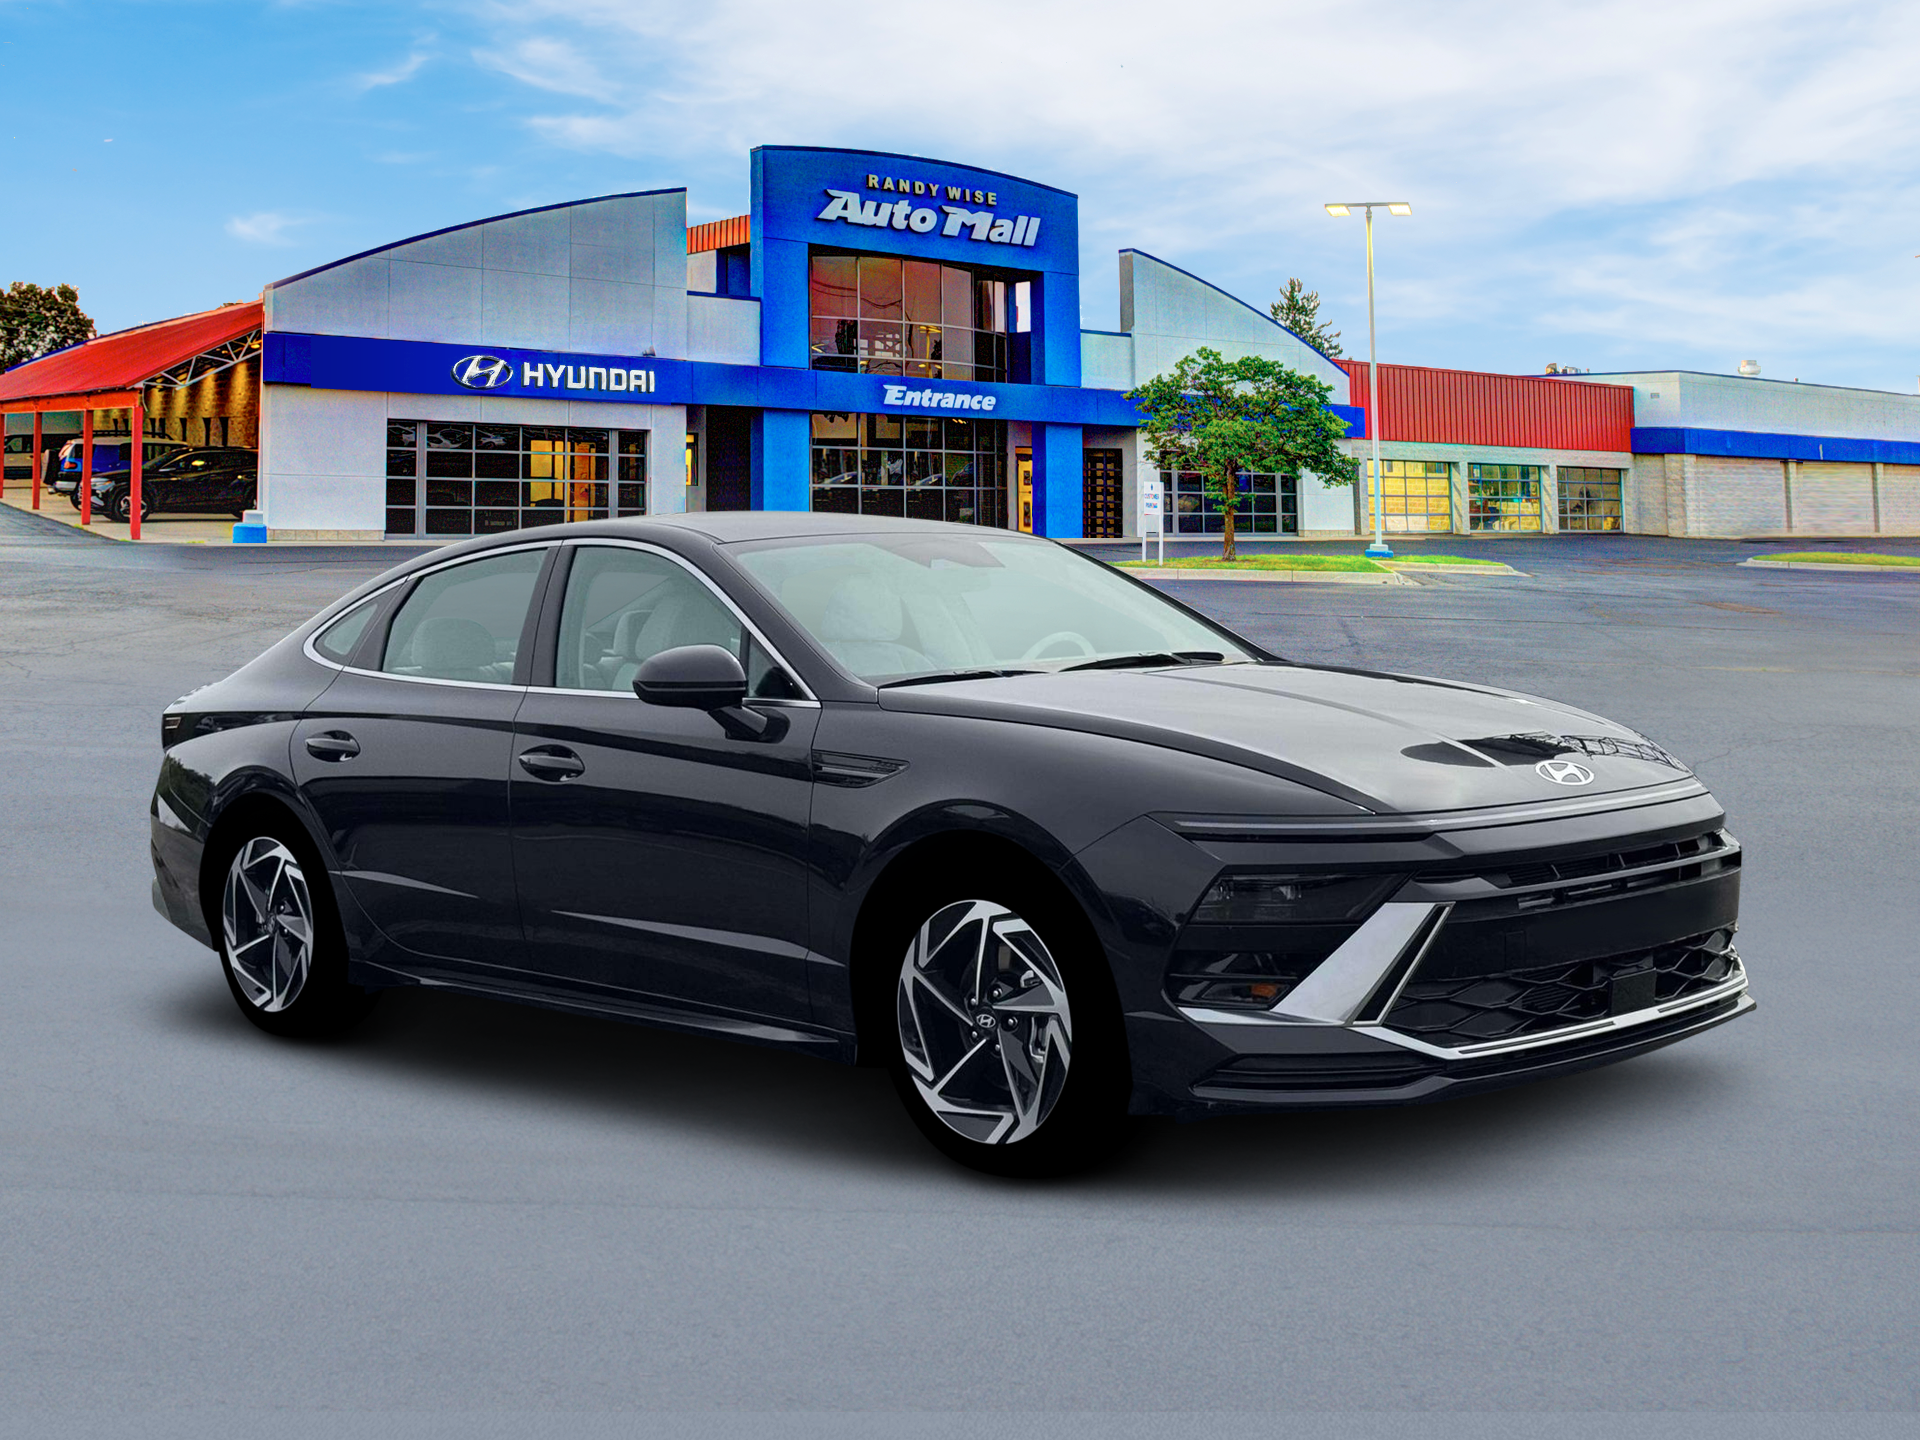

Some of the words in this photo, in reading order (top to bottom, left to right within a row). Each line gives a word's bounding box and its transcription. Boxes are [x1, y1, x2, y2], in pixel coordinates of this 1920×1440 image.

[867, 174, 940, 197] RANDY
[946, 186, 998, 206] WISE
[816, 189, 938, 233] Auto
[941, 205, 1042, 247] Mall
[522, 361, 656, 393] HYUNDAI
[883, 384, 997, 411] Entrance
